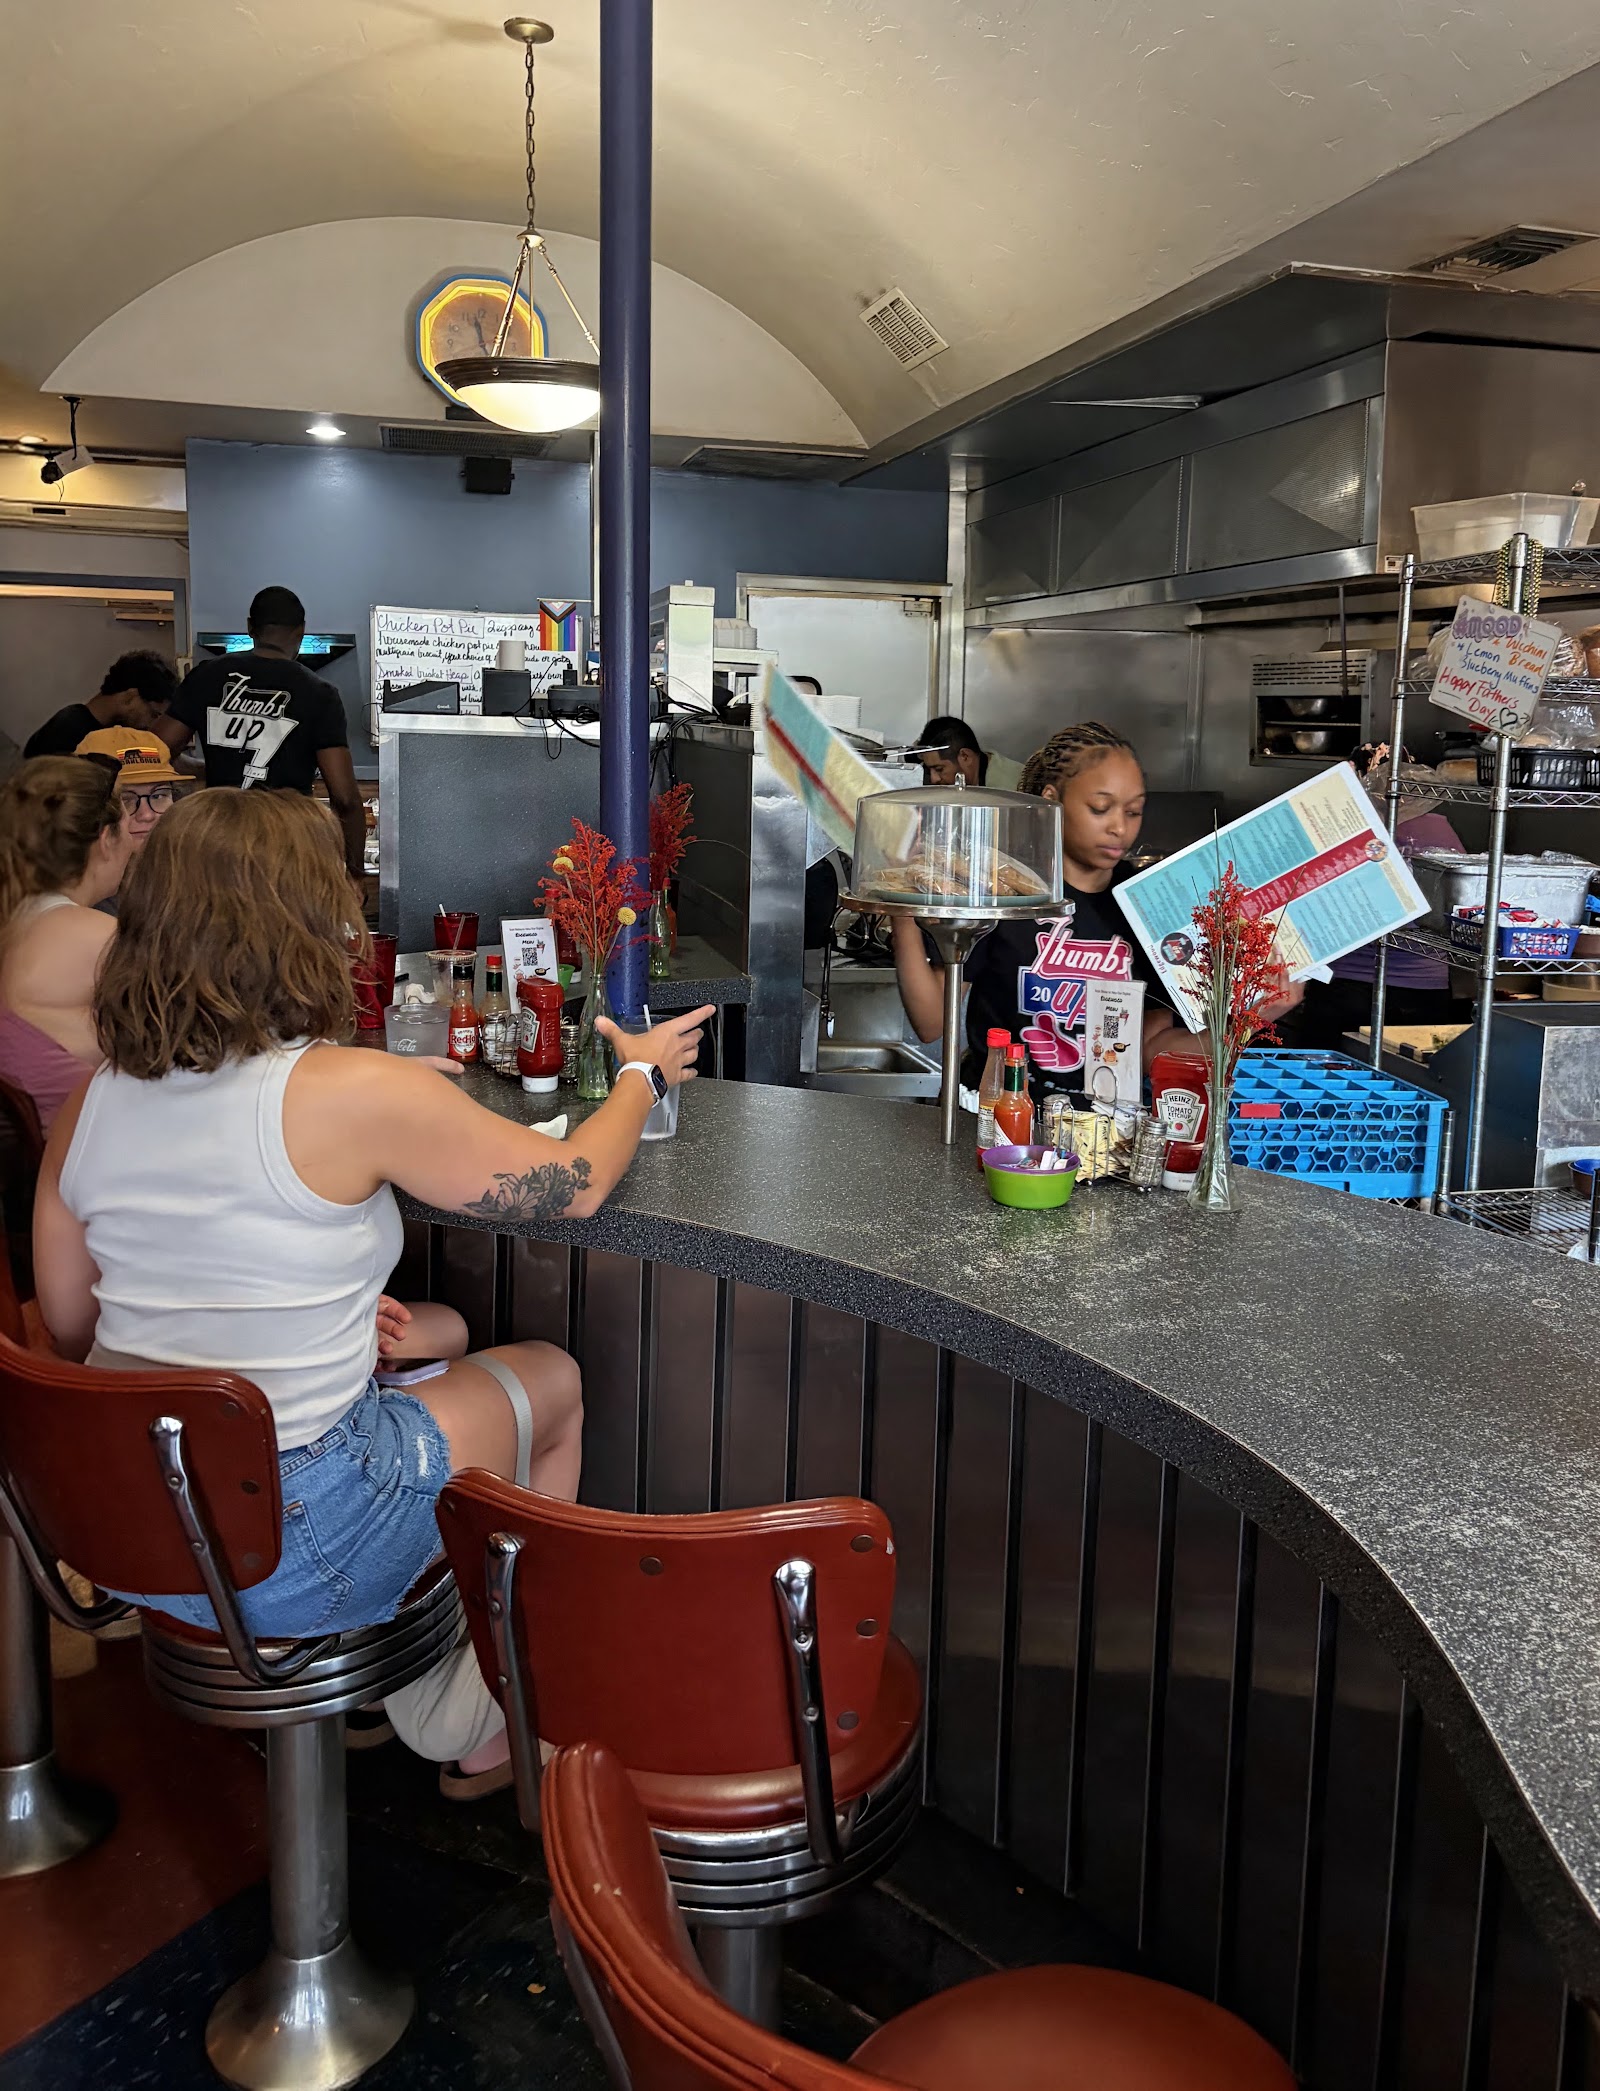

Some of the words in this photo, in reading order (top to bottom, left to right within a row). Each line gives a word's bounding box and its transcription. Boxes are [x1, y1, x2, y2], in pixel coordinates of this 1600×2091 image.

[378, 613, 429, 632] Chicken
[433, 617, 455, 634] Pot
[459, 618, 479, 635] Pie
[378, 631, 430, 646] housemade
[432, 636, 466, 649] chicken
[467, 640, 481, 653] pot
[482, 643, 495, 653] pie
[1466, 642, 1501, 663] Lemon
[462, 651, 485, 661] choice
[1507, 651, 1545, 678] Bread
[416, 666, 444, 678] brisket
[1503, 671, 1539, 694] Muffins
[217, 672, 286, 718] Thumbs
[1438, 666, 1476, 695] Happy
[1475, 680, 1520, 709] Father's
[1467, 697, 1497, 723] Day
[1030, 915, 1132, 975] Thumbs
[1030, 985, 1051, 1003] 20
[1167, 1105, 1193, 1114] TOMATO
[1168, 1095, 1191, 1105] HEINZ
